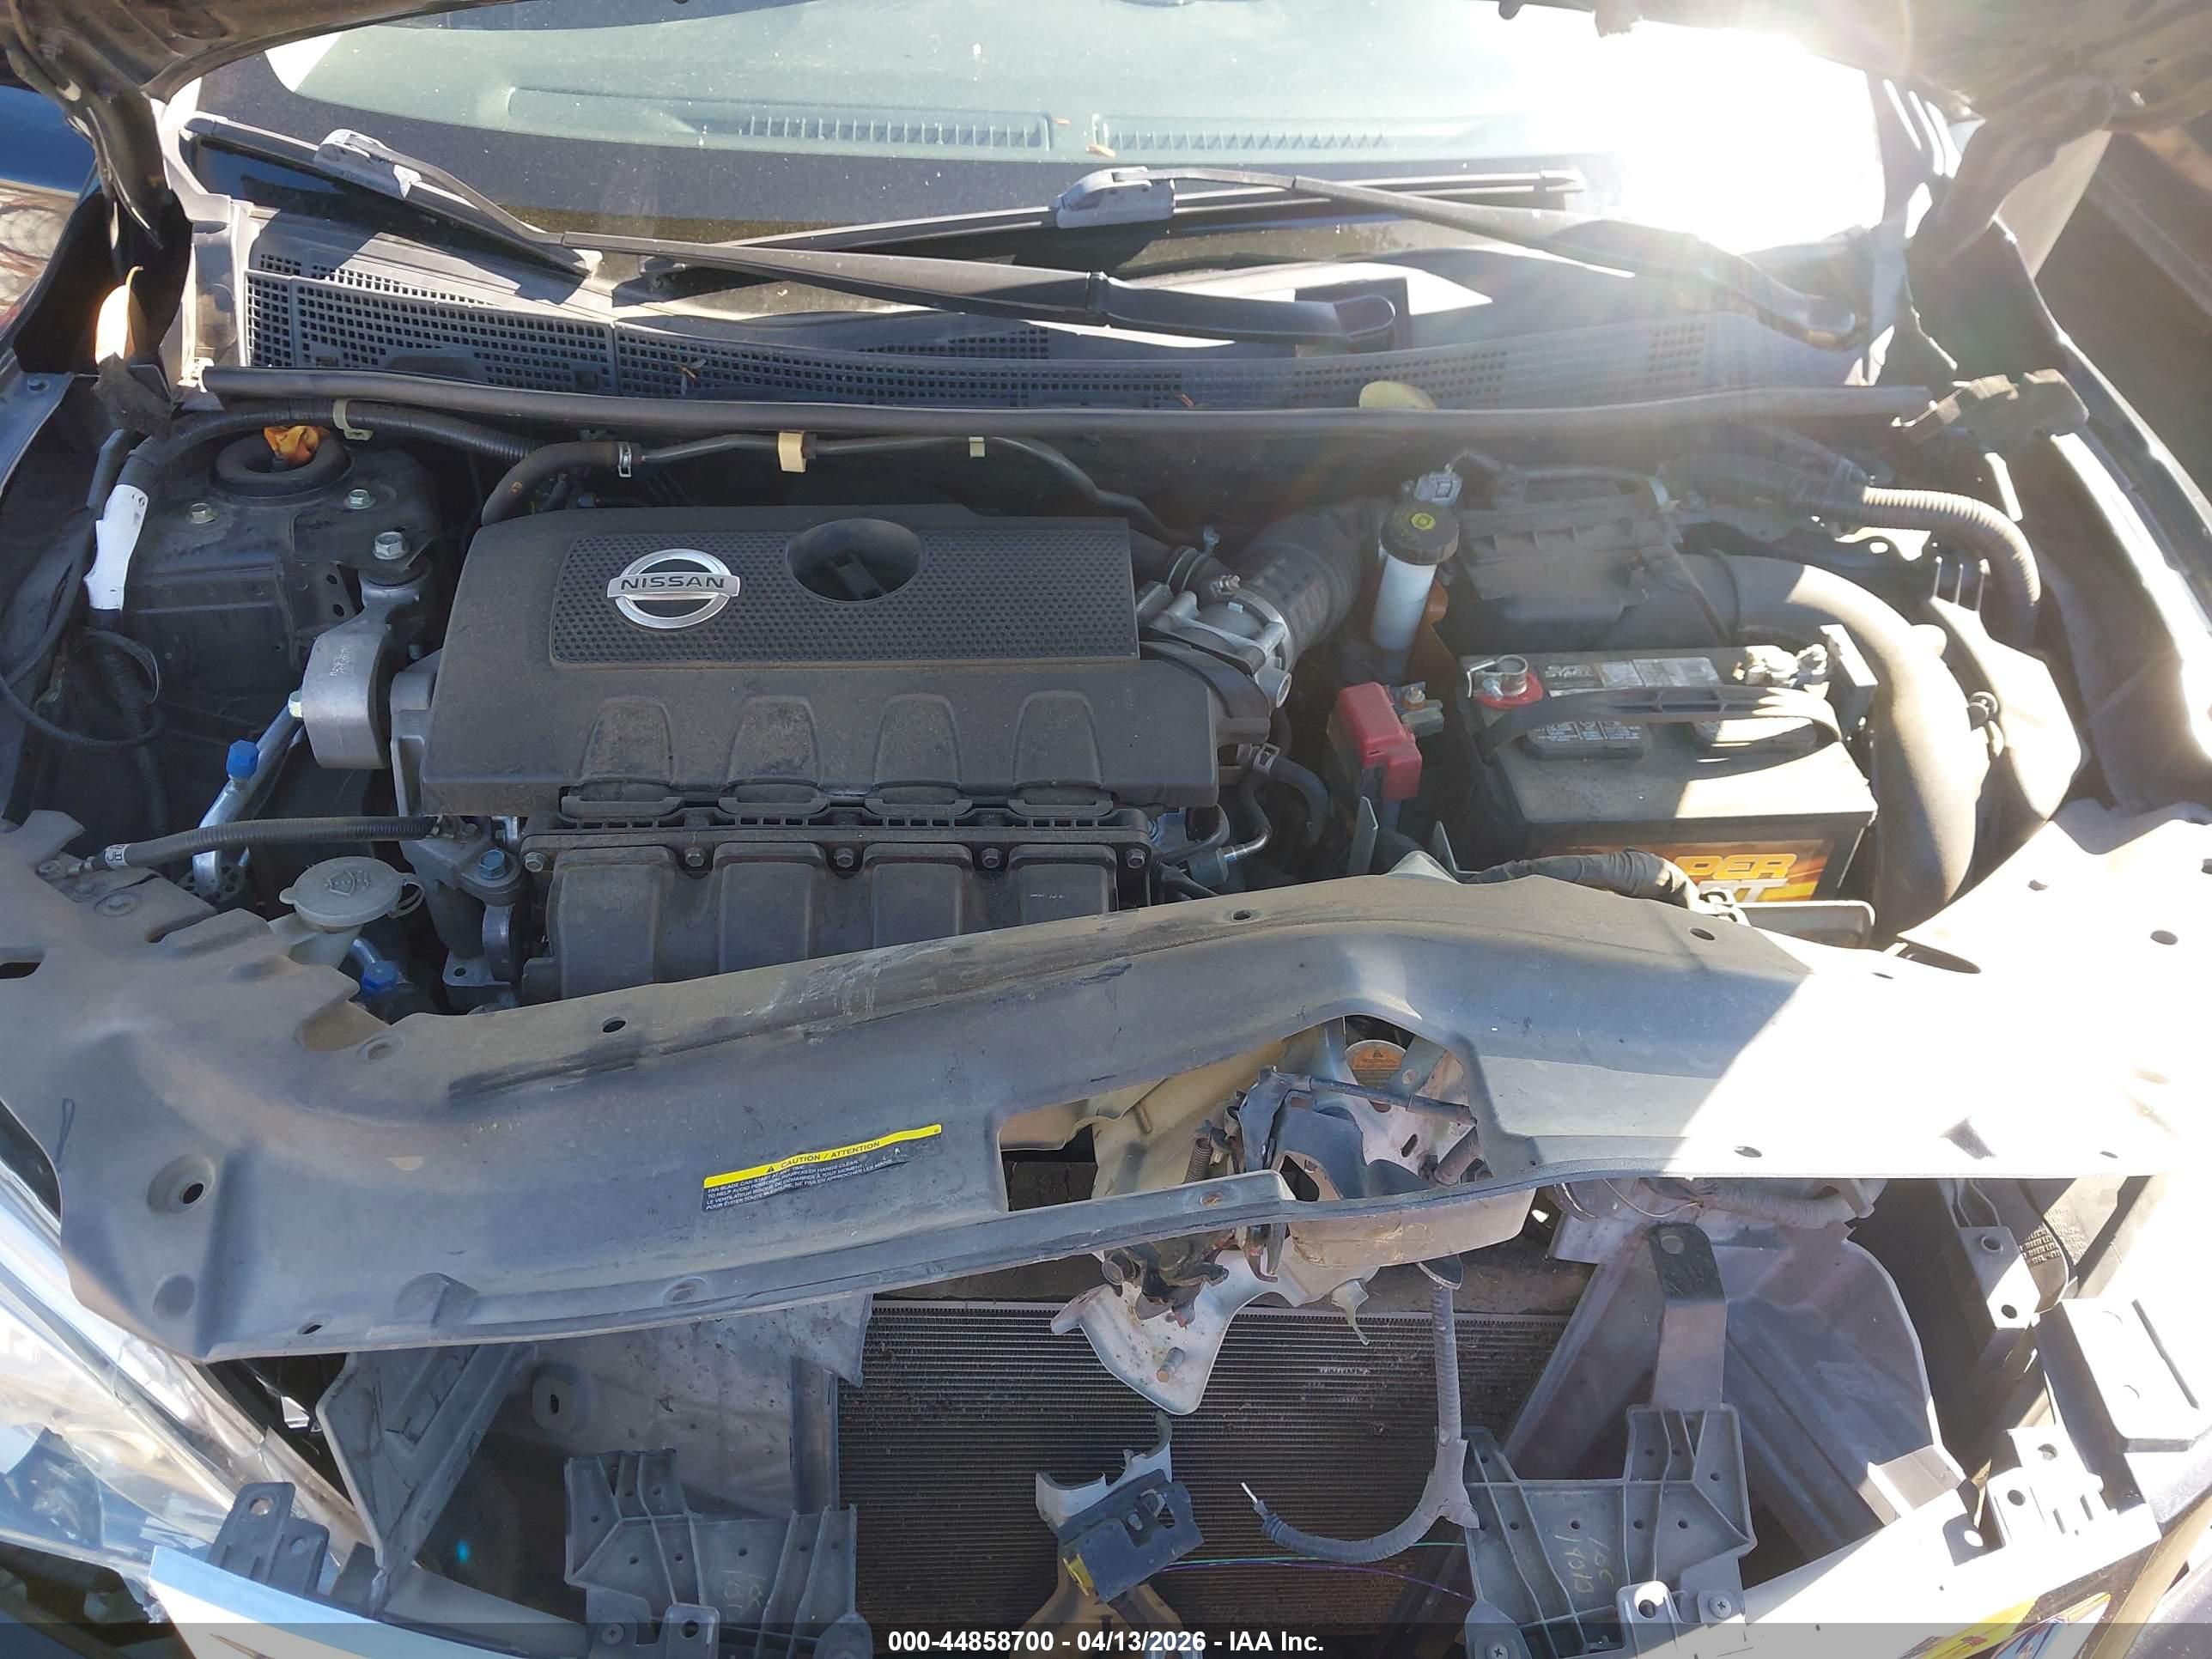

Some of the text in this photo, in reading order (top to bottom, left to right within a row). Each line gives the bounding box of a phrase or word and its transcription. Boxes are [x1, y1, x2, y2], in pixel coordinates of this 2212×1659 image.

[621, 576, 725, 591] NISSAN
[781, 1154, 821, 1168] CAUTION
[830, 1141, 880, 1158] ATTENTION
[720, 1182, 738, 1191] BLADE
[753, 1176, 772, 1184] START
[732, 1185, 750, 1194] AVOID
[751, 1176, 781, 1189] PERSONAL
[714, 1190, 752, 1203] VENTILATEUR
[752, 1185, 774, 1194] RISQUE
